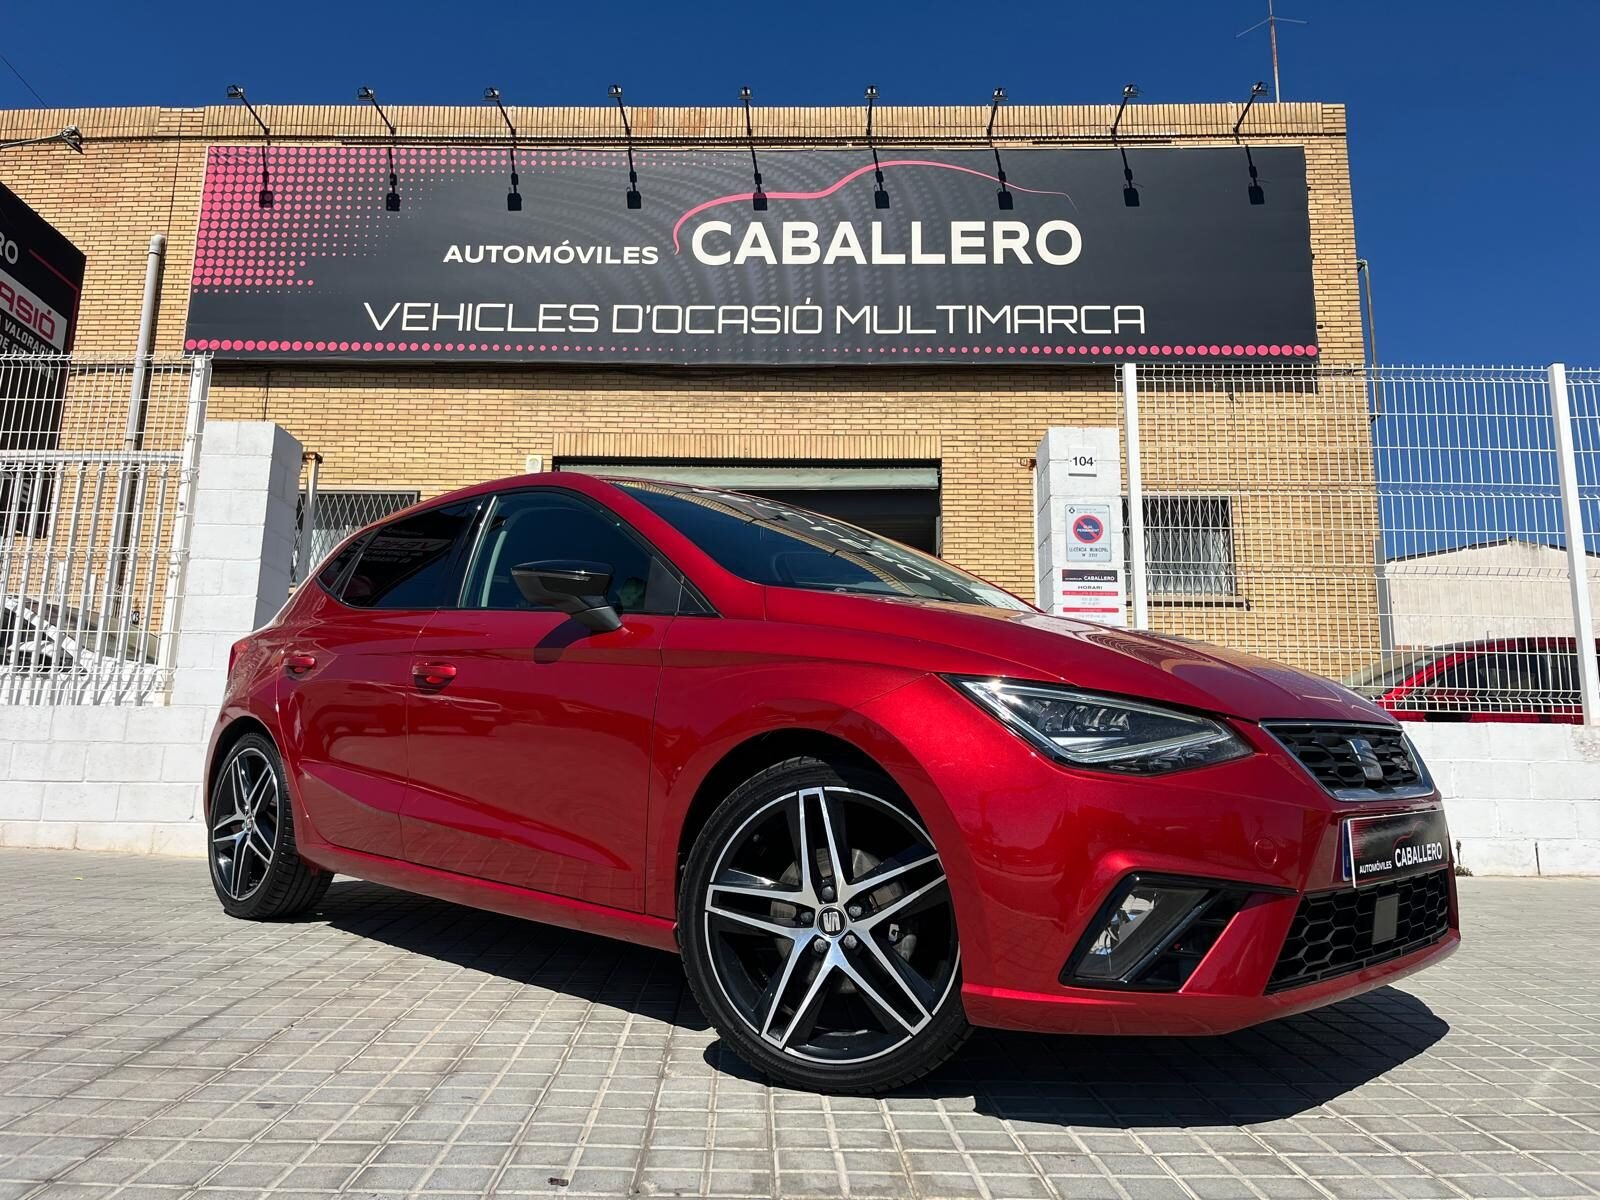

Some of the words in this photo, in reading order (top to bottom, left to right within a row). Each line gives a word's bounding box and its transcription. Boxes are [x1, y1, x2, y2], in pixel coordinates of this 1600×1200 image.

[443, 240, 659, 264] AUTOMÓVILES
[691, 220, 1082, 266] CABALLERO
[363, 302, 600, 333] VEHICLES
[612, 298, 822, 334] D'OCASIÓ
[835, 305, 1145, 334] MULTIMARCA
[1072, 456, 1094, 467] 104
[1359, 860, 1393, 874] AUTOMÓVILES
[1394, 841, 1443, 867] CABALLERO
